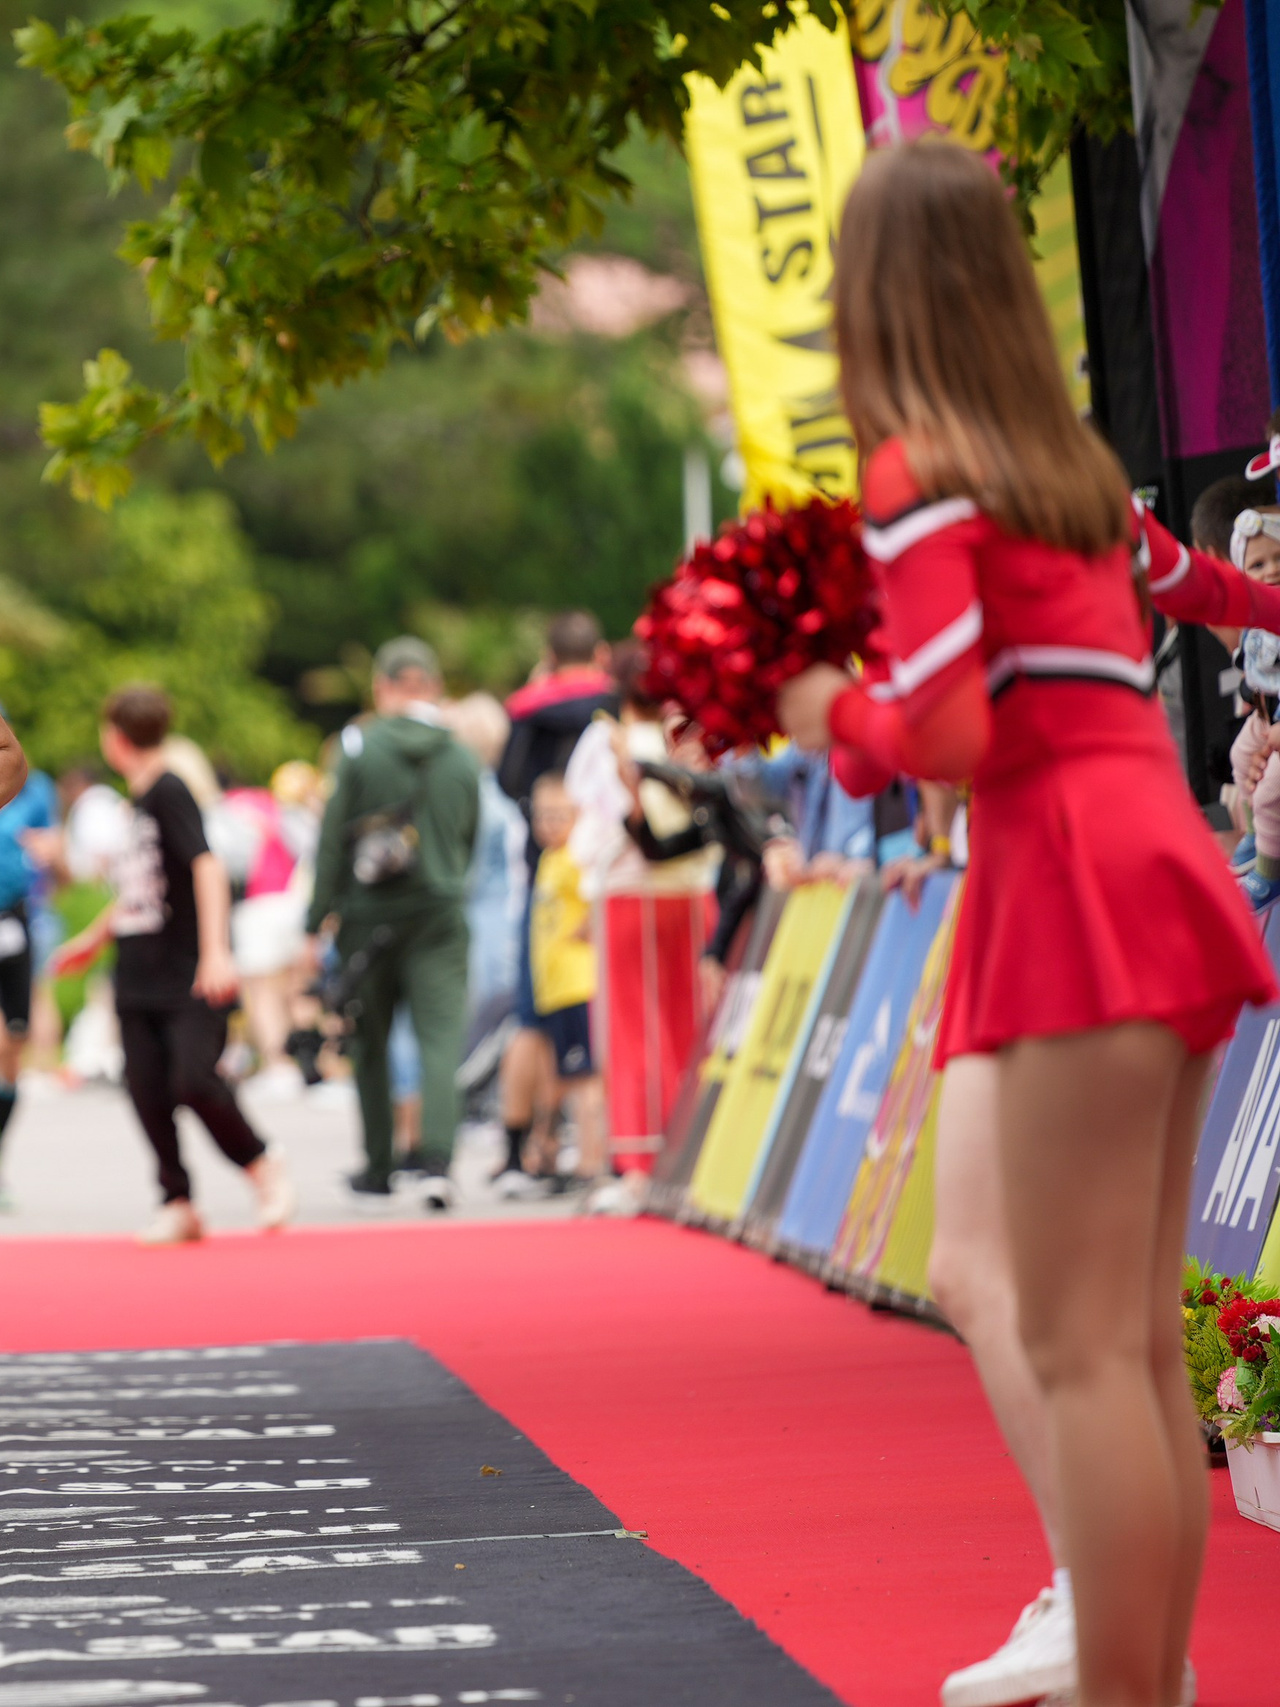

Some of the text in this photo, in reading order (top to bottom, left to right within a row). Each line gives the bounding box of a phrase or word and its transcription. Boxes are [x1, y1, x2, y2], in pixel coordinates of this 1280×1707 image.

[740, 79, 814, 284] STAR
[47, 1424, 335, 1438] STAR
[59, 1478, 371, 1491] STAR
[57, 1523, 400, 1548] STAR
[60, 1550, 421, 1576] STAR
[86, 1624, 497, 1654] STAR
